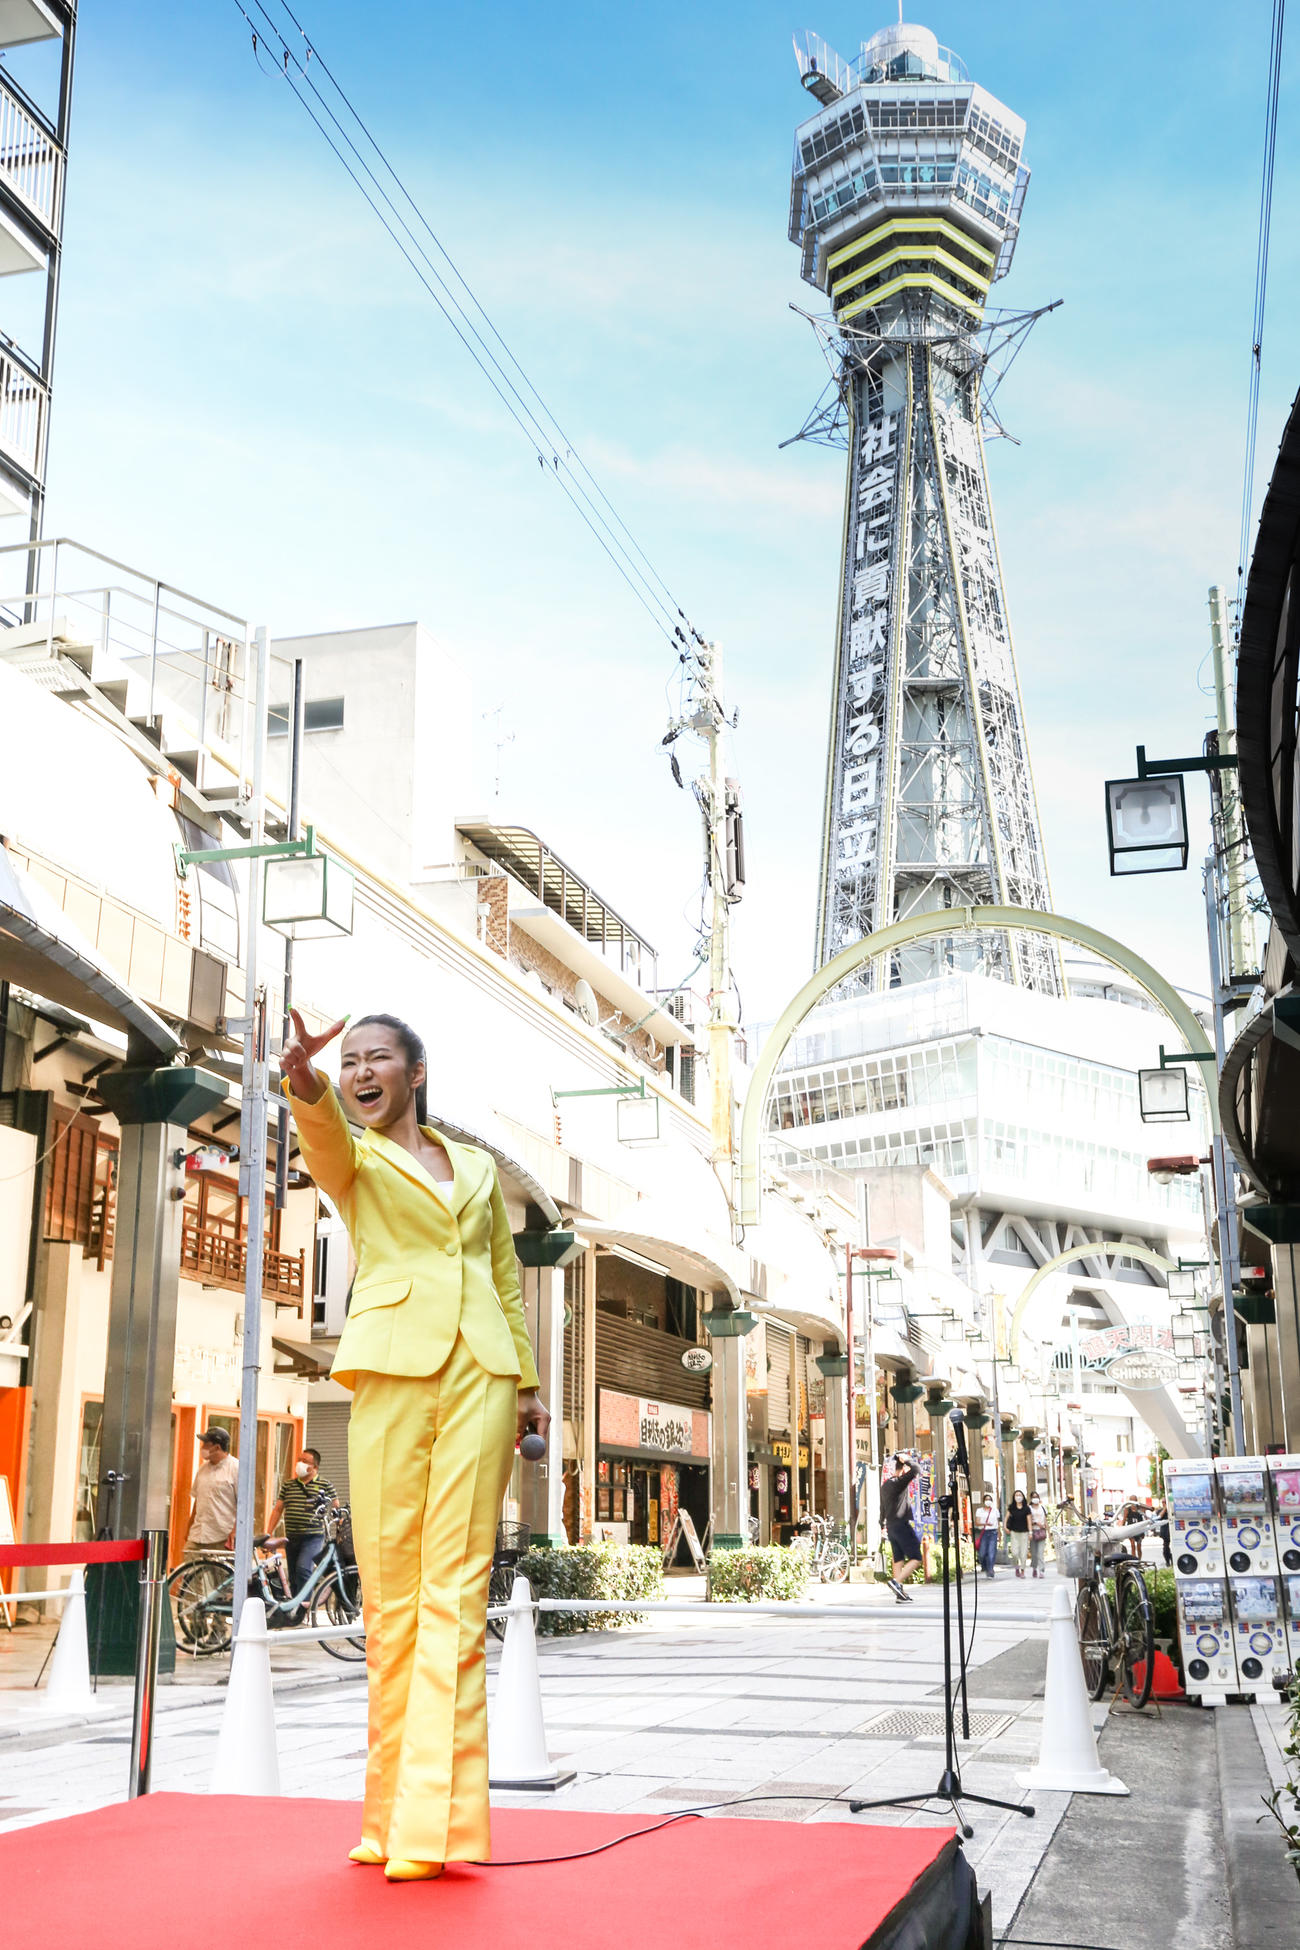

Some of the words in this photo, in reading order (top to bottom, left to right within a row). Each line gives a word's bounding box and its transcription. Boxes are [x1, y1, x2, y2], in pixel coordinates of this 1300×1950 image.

[836, 415, 898, 872] 社会に貢献する日立
